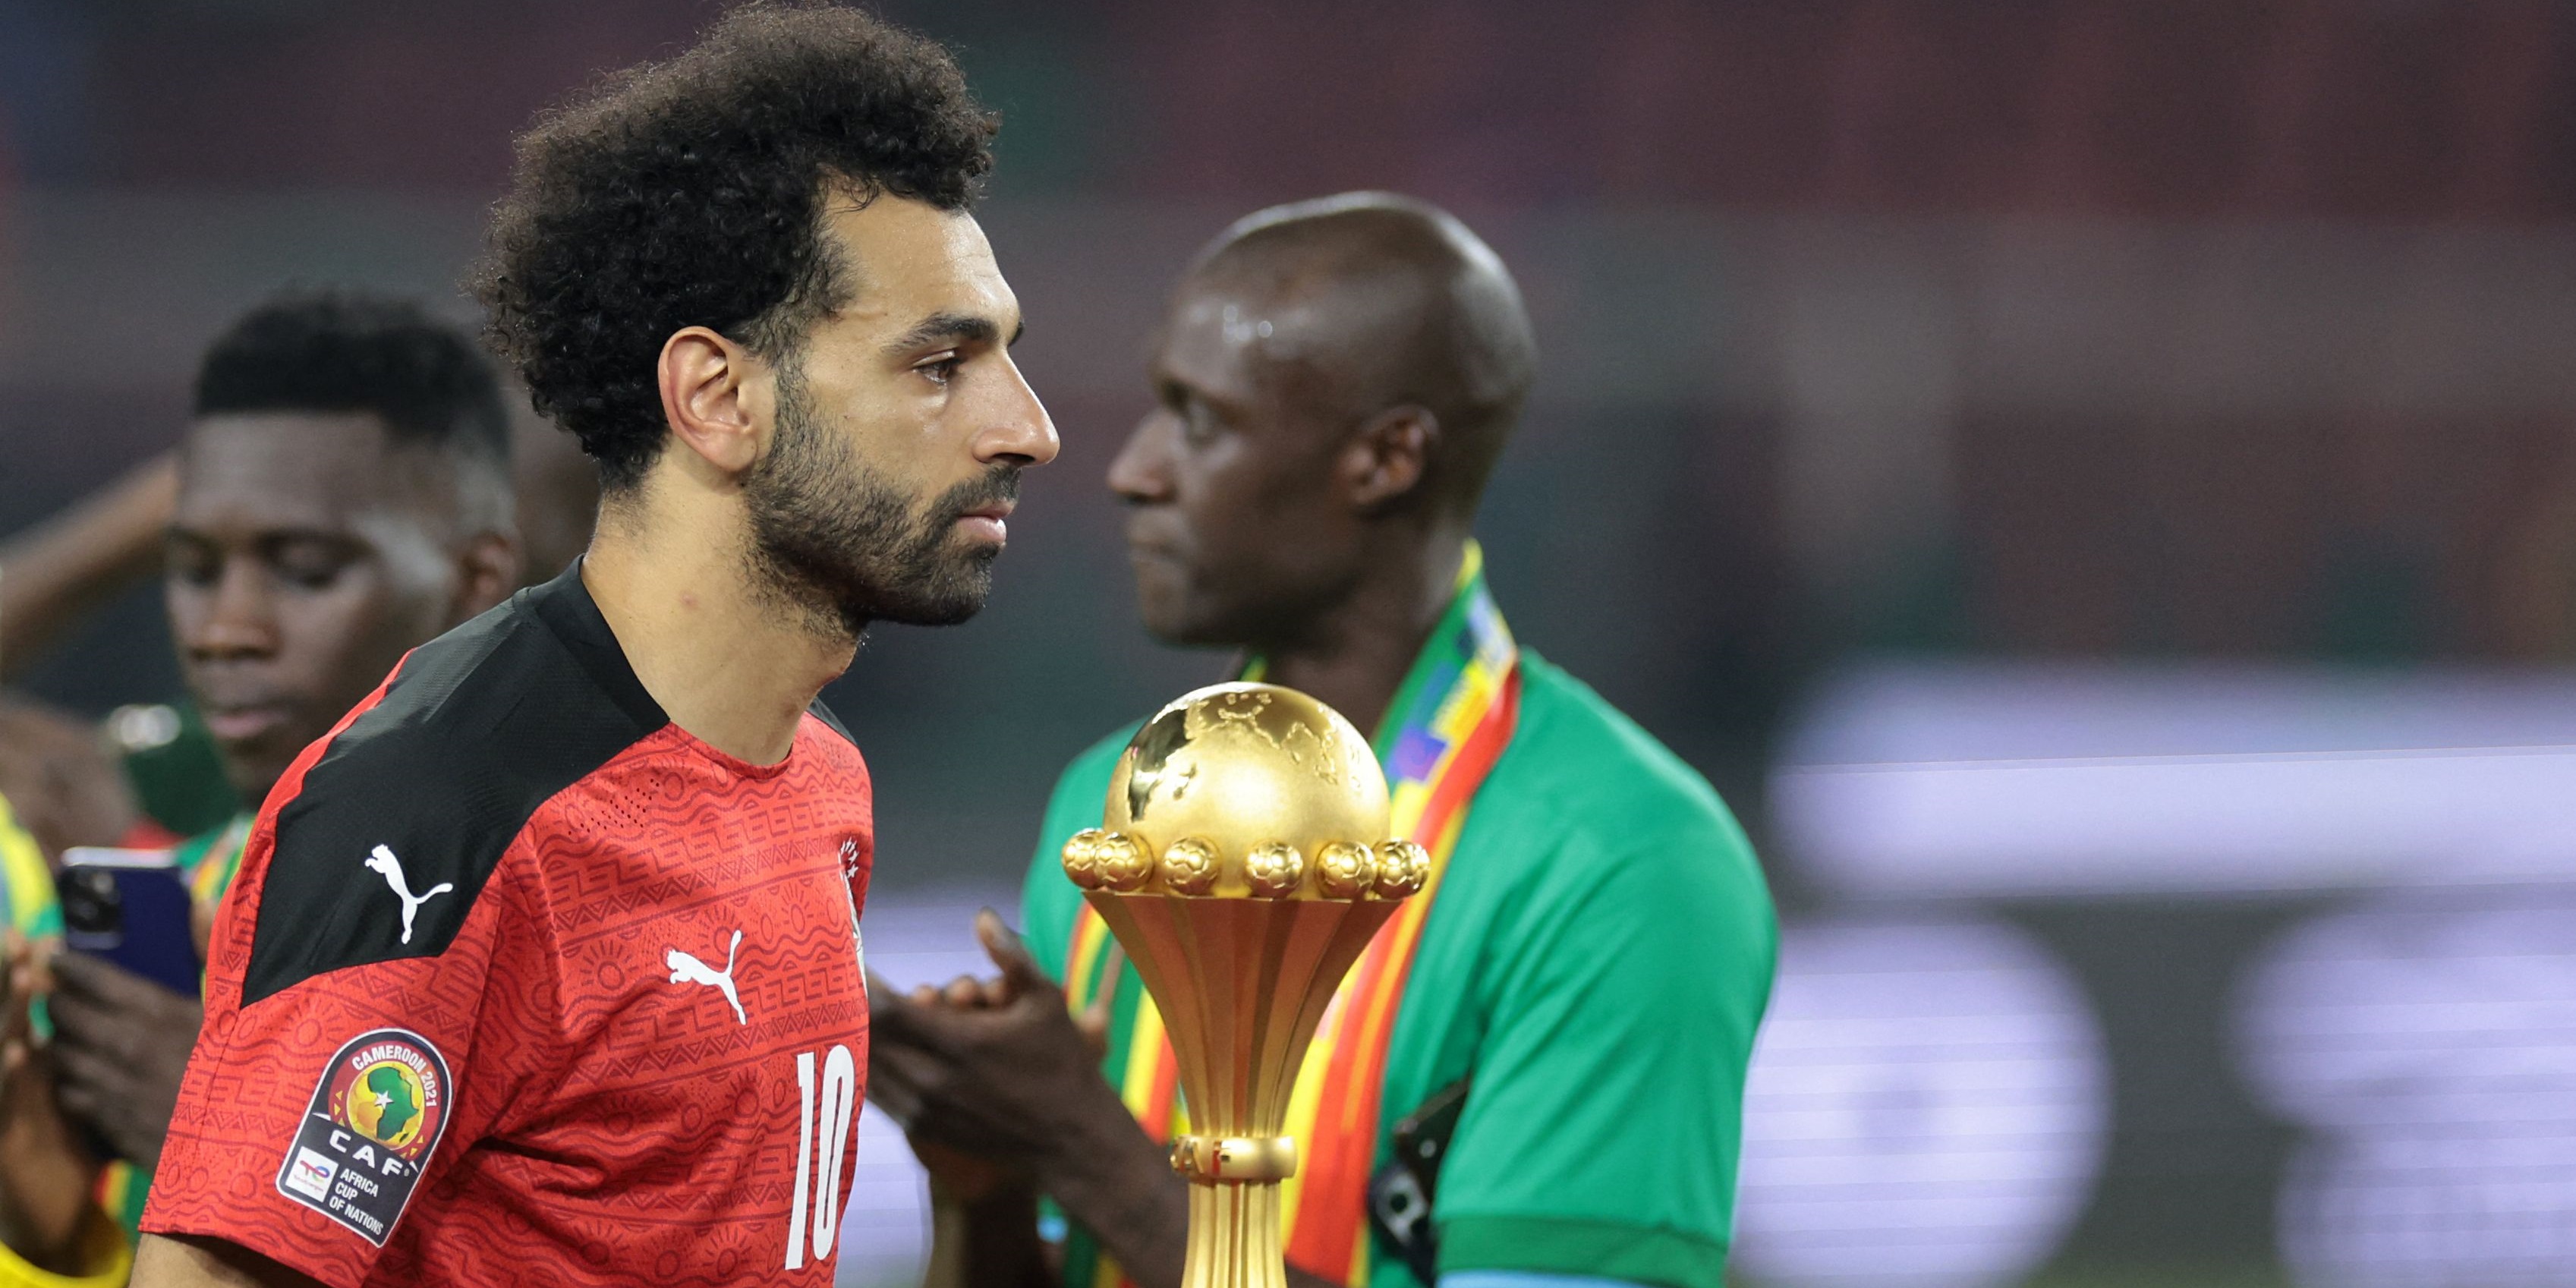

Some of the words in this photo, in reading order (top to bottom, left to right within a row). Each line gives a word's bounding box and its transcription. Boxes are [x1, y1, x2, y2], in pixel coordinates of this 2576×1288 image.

[351, 1045, 427, 1071] CAMEROON
[421, 1071, 437, 1107] 2021
[329, 1129, 404, 1176] CAF
[785, 1044, 855, 1271] 10
[335, 1182, 359, 1201] CUP
[340, 1168, 379, 1197] AFRICA
[329, 1195, 345, 1211] OF
[345, 1204, 383, 1236] NATIONS
